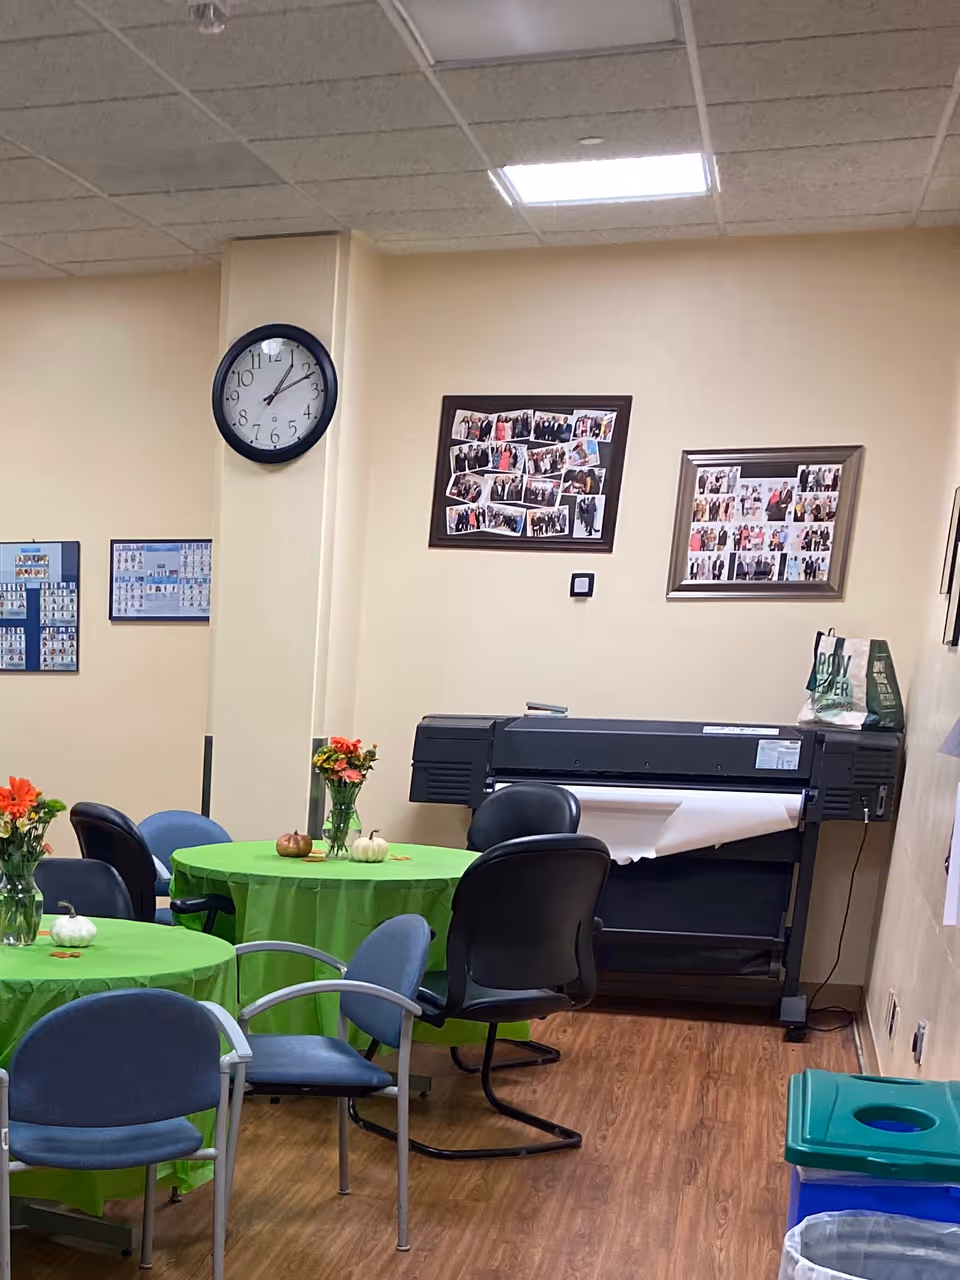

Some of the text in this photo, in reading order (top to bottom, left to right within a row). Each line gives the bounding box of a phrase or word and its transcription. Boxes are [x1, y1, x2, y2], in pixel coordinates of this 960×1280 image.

[251, 352, 262, 369] 11
[237, 369, 254, 388] 10
[301, 362, 313, 379] 2
[230, 390, 239, 408] 9
[311, 383, 320, 400] 3
[238, 409, 249, 427] 8
[302, 403, 312, 420] 4
[252, 424, 261, 440] 7
[270, 427, 280, 444] 6
[288, 419, 298, 437] 5
